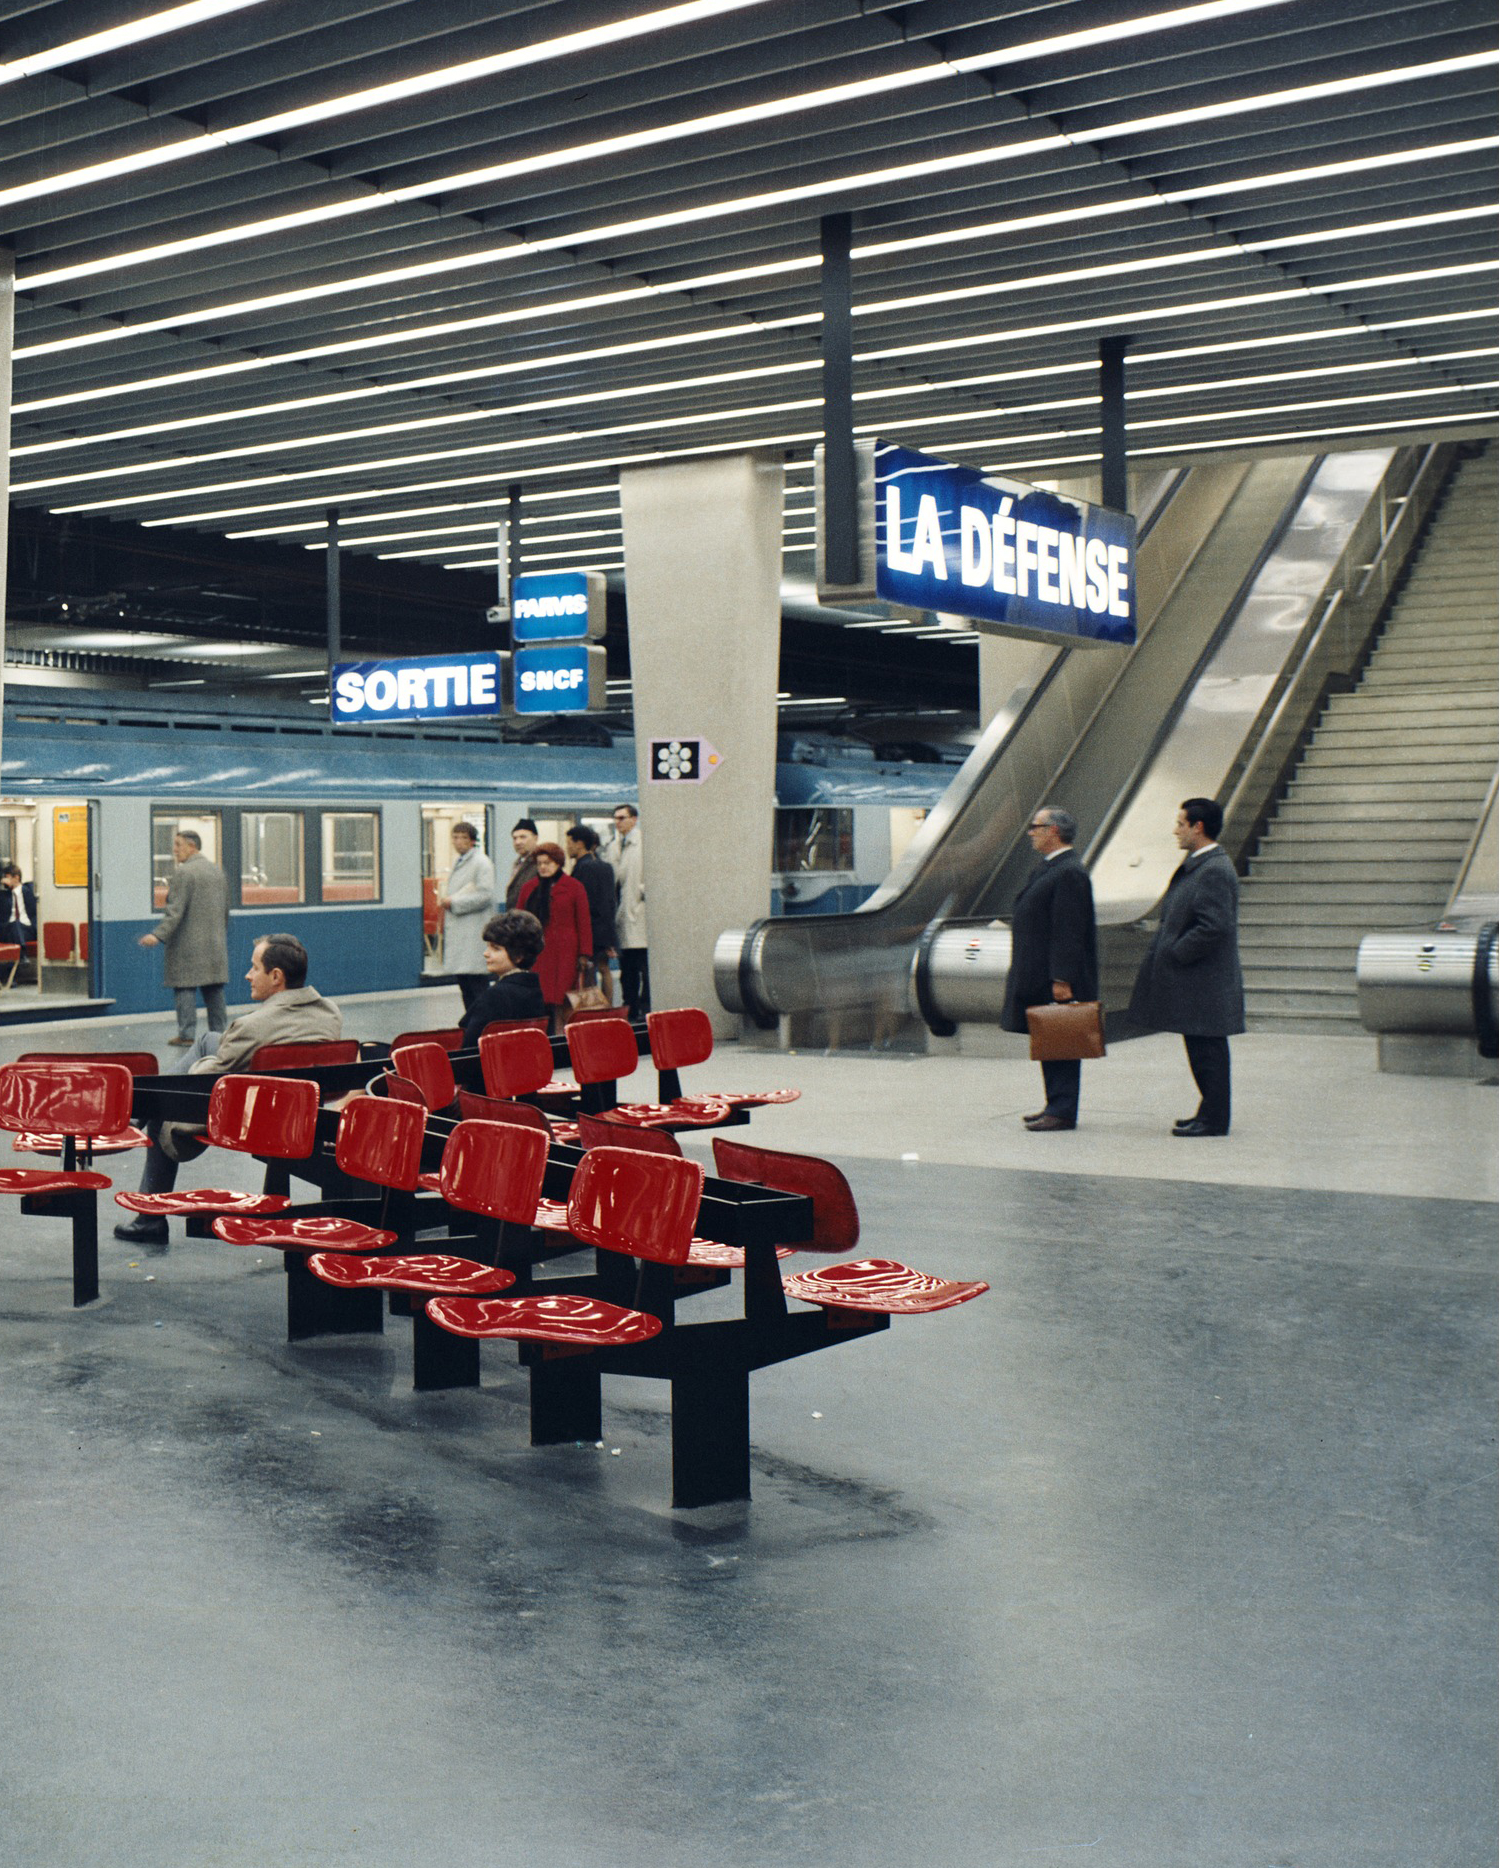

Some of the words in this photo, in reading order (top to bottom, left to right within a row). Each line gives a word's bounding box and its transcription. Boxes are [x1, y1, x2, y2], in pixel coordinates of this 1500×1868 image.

[886, 485, 948, 580] LA
[961, 496, 1129, 617] DÉFENSE
[514, 594, 588, 618] PARVIS
[336, 664, 496, 712] SORTIE
[520, 669, 583, 691] SNCF
